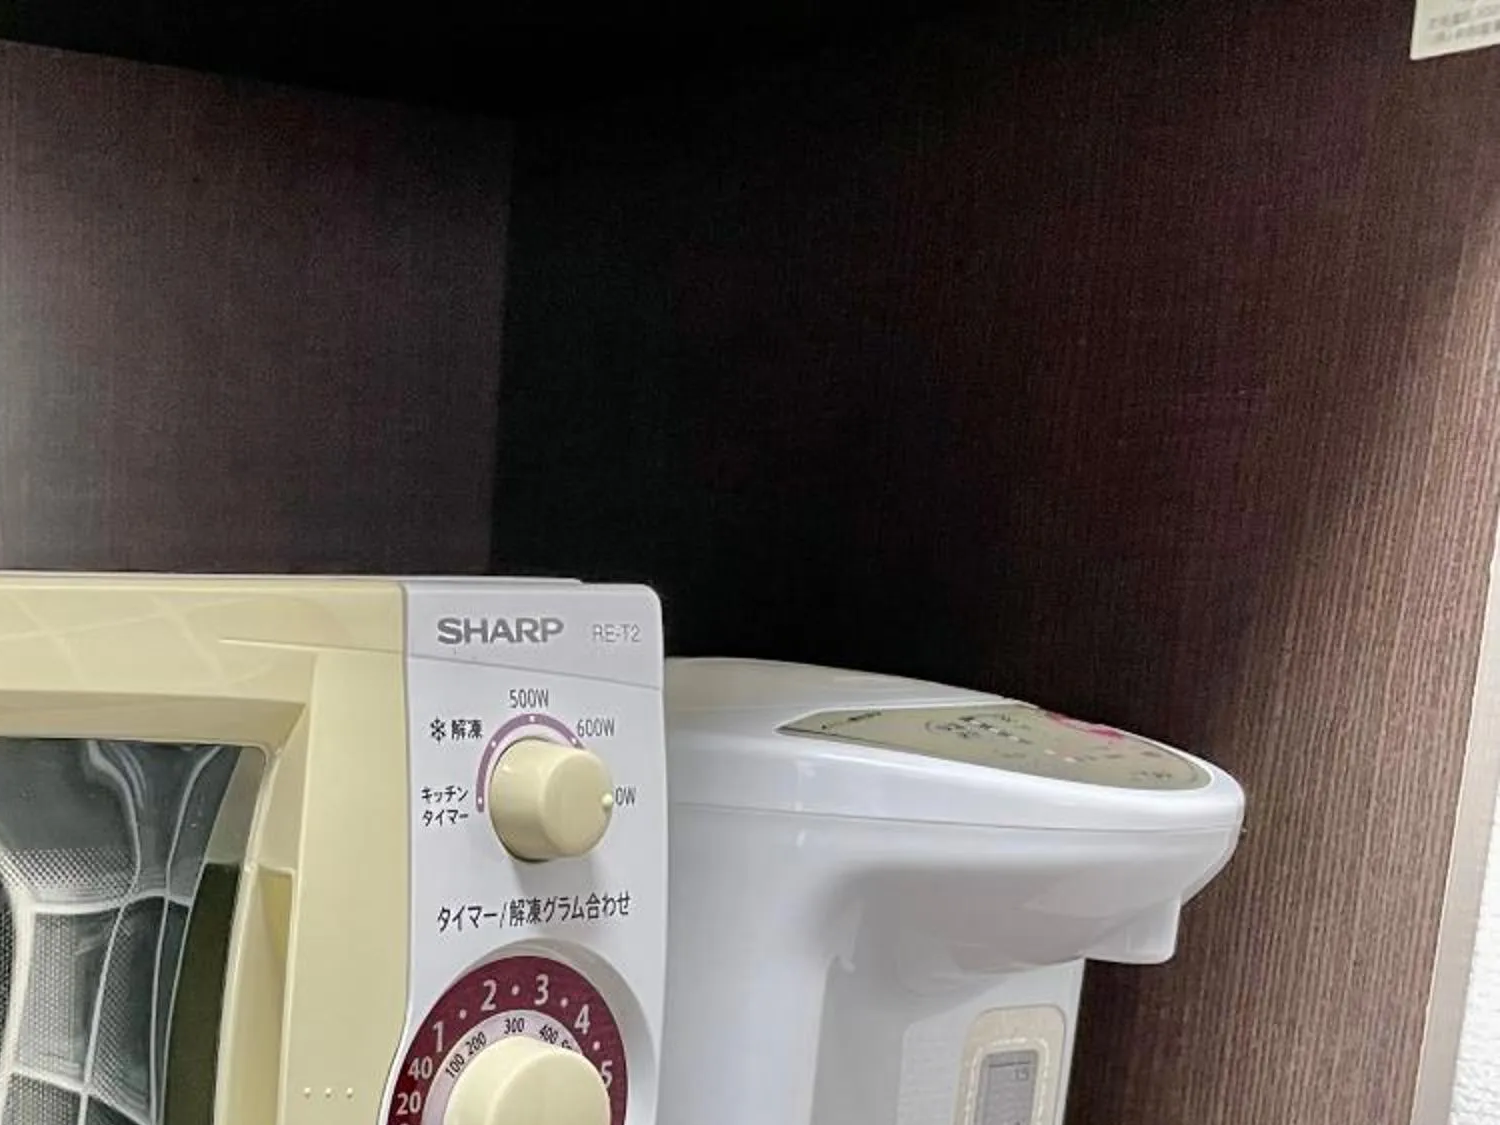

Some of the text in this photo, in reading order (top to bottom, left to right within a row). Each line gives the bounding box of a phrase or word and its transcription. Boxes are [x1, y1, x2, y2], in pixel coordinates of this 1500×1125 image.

[437, 617, 642, 645] SHARP RE-T2
[509, 689, 549, 709] 500W
[451, 719, 483, 741] 解凍
[577, 718, 615, 738] 600W
[421, 785, 469, 804] キッチン
[615, 786, 637, 807] 0W
[423, 809, 469, 827] タイマー
[480, 979, 498, 1011] 2
[534, 973, 549, 1006] 3
[503, 1017, 526, 1035] 300
[574, 1003, 591, 1035] 4
[432, 1020, 445, 1053] 1
[465, 1031, 488, 1057] 200
[539, 1023, 560, 1045] 400
[408, 1056, 433, 1080] 40
[444, 1052, 466, 1079] 100
[600, 1060, 614, 1089] 5
[396, 1091, 422, 1116] 20
